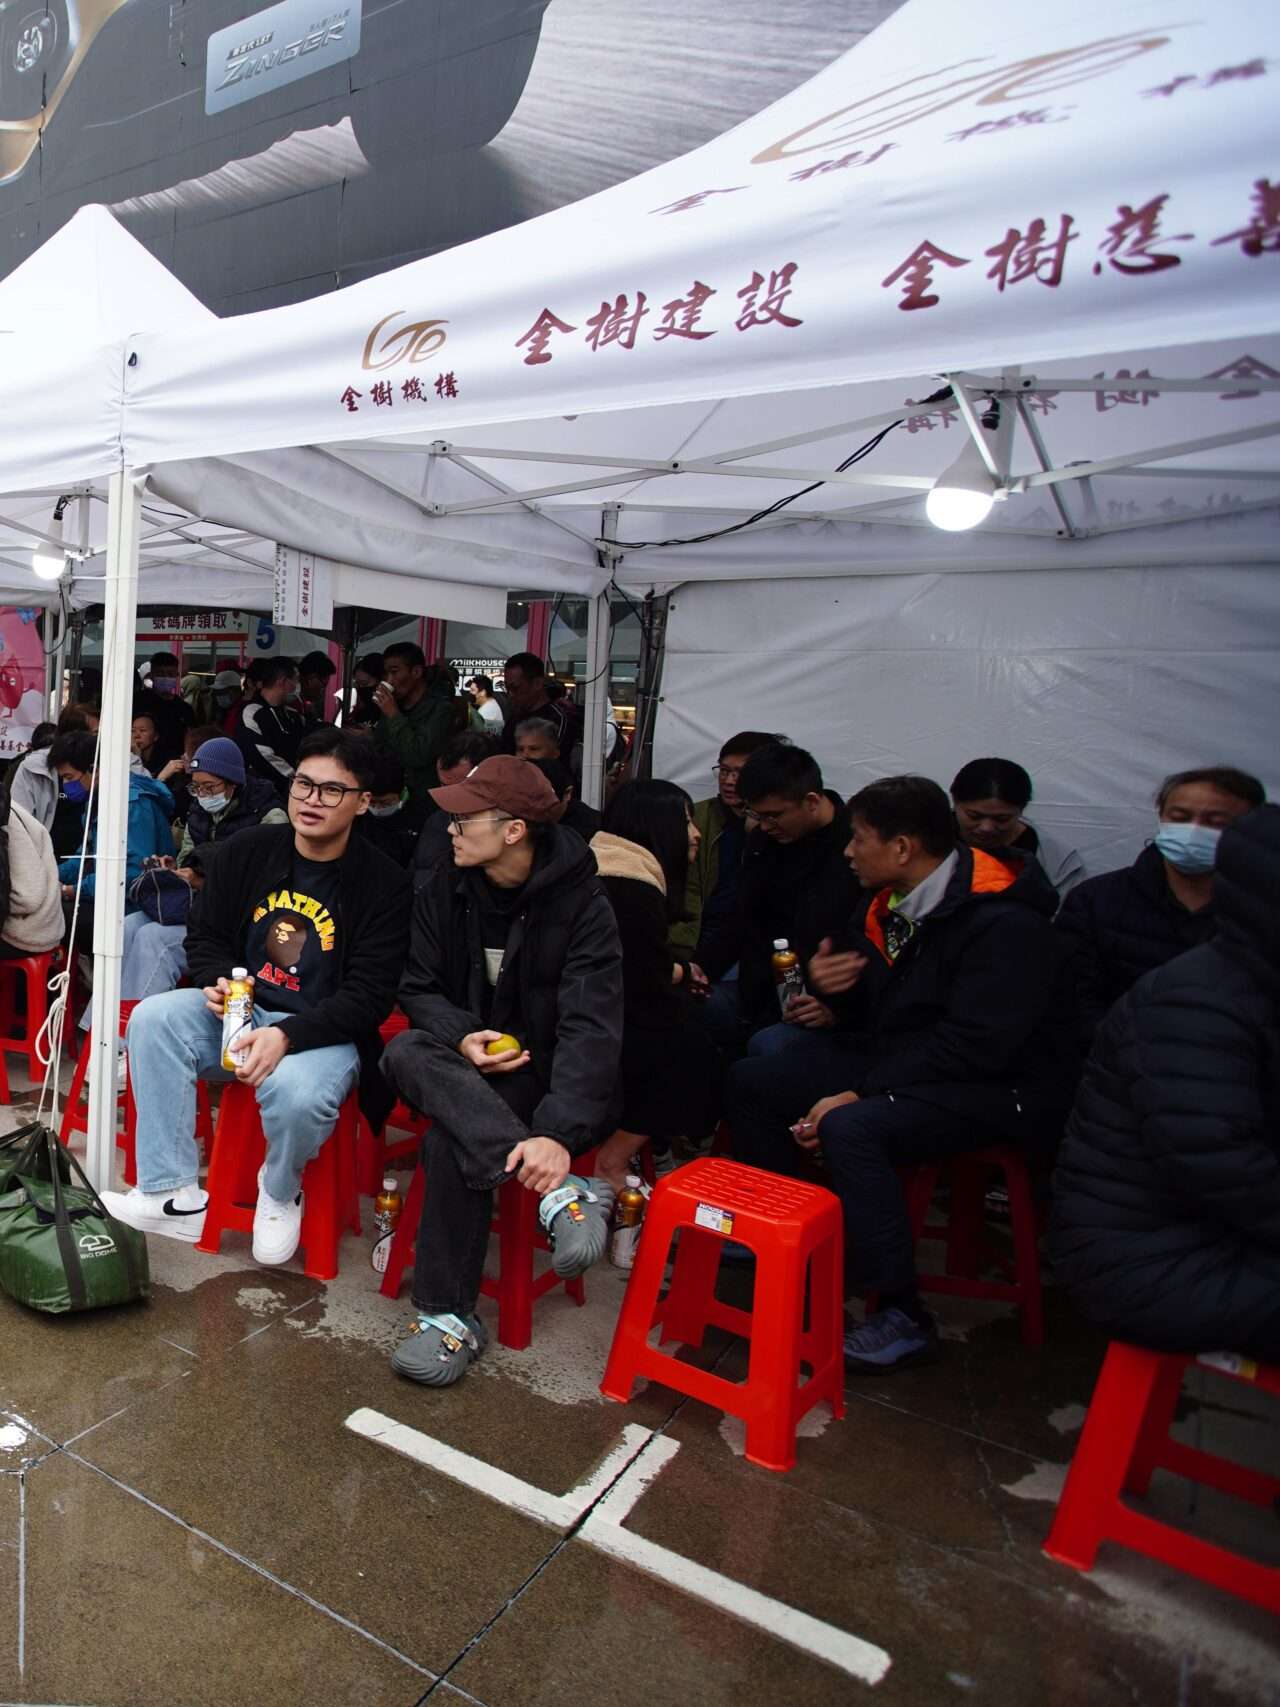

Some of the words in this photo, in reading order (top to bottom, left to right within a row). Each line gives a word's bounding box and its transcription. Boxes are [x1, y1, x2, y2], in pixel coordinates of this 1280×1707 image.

[214, 20, 347, 91] ZINGER
[515, 262, 804, 366] 金樹建設
[340, 371, 459, 412] 金樹機構
[255, 617, 277, 650] 5
[257, 962, 300, 992] APE
